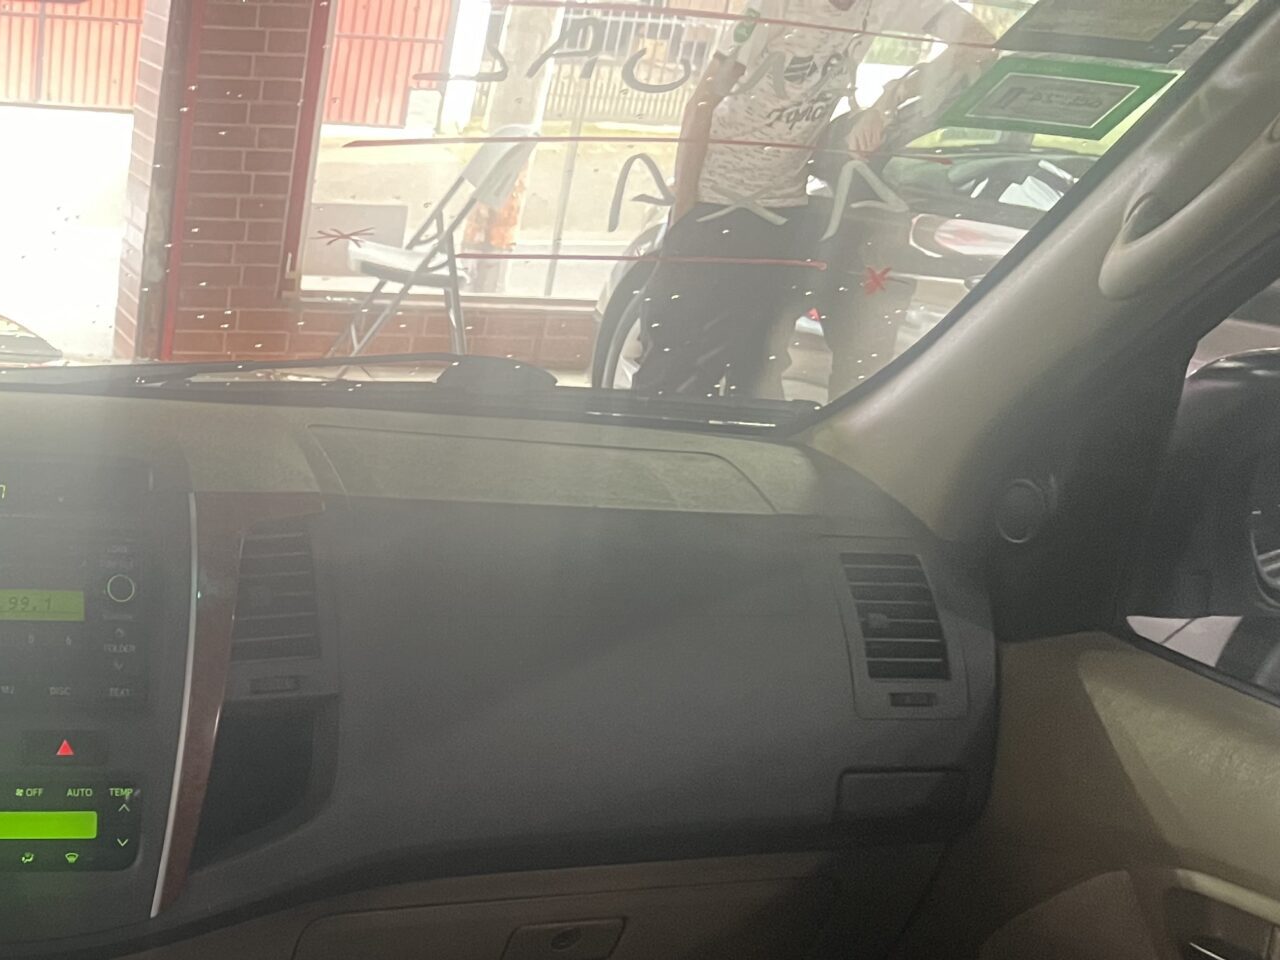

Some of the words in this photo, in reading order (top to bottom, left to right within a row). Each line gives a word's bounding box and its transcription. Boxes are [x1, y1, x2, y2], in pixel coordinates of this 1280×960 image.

[25, 788, 44, 797] OFF
[66, 788, 93, 798] AUTO
[109, 787, 134, 798] TEMP
